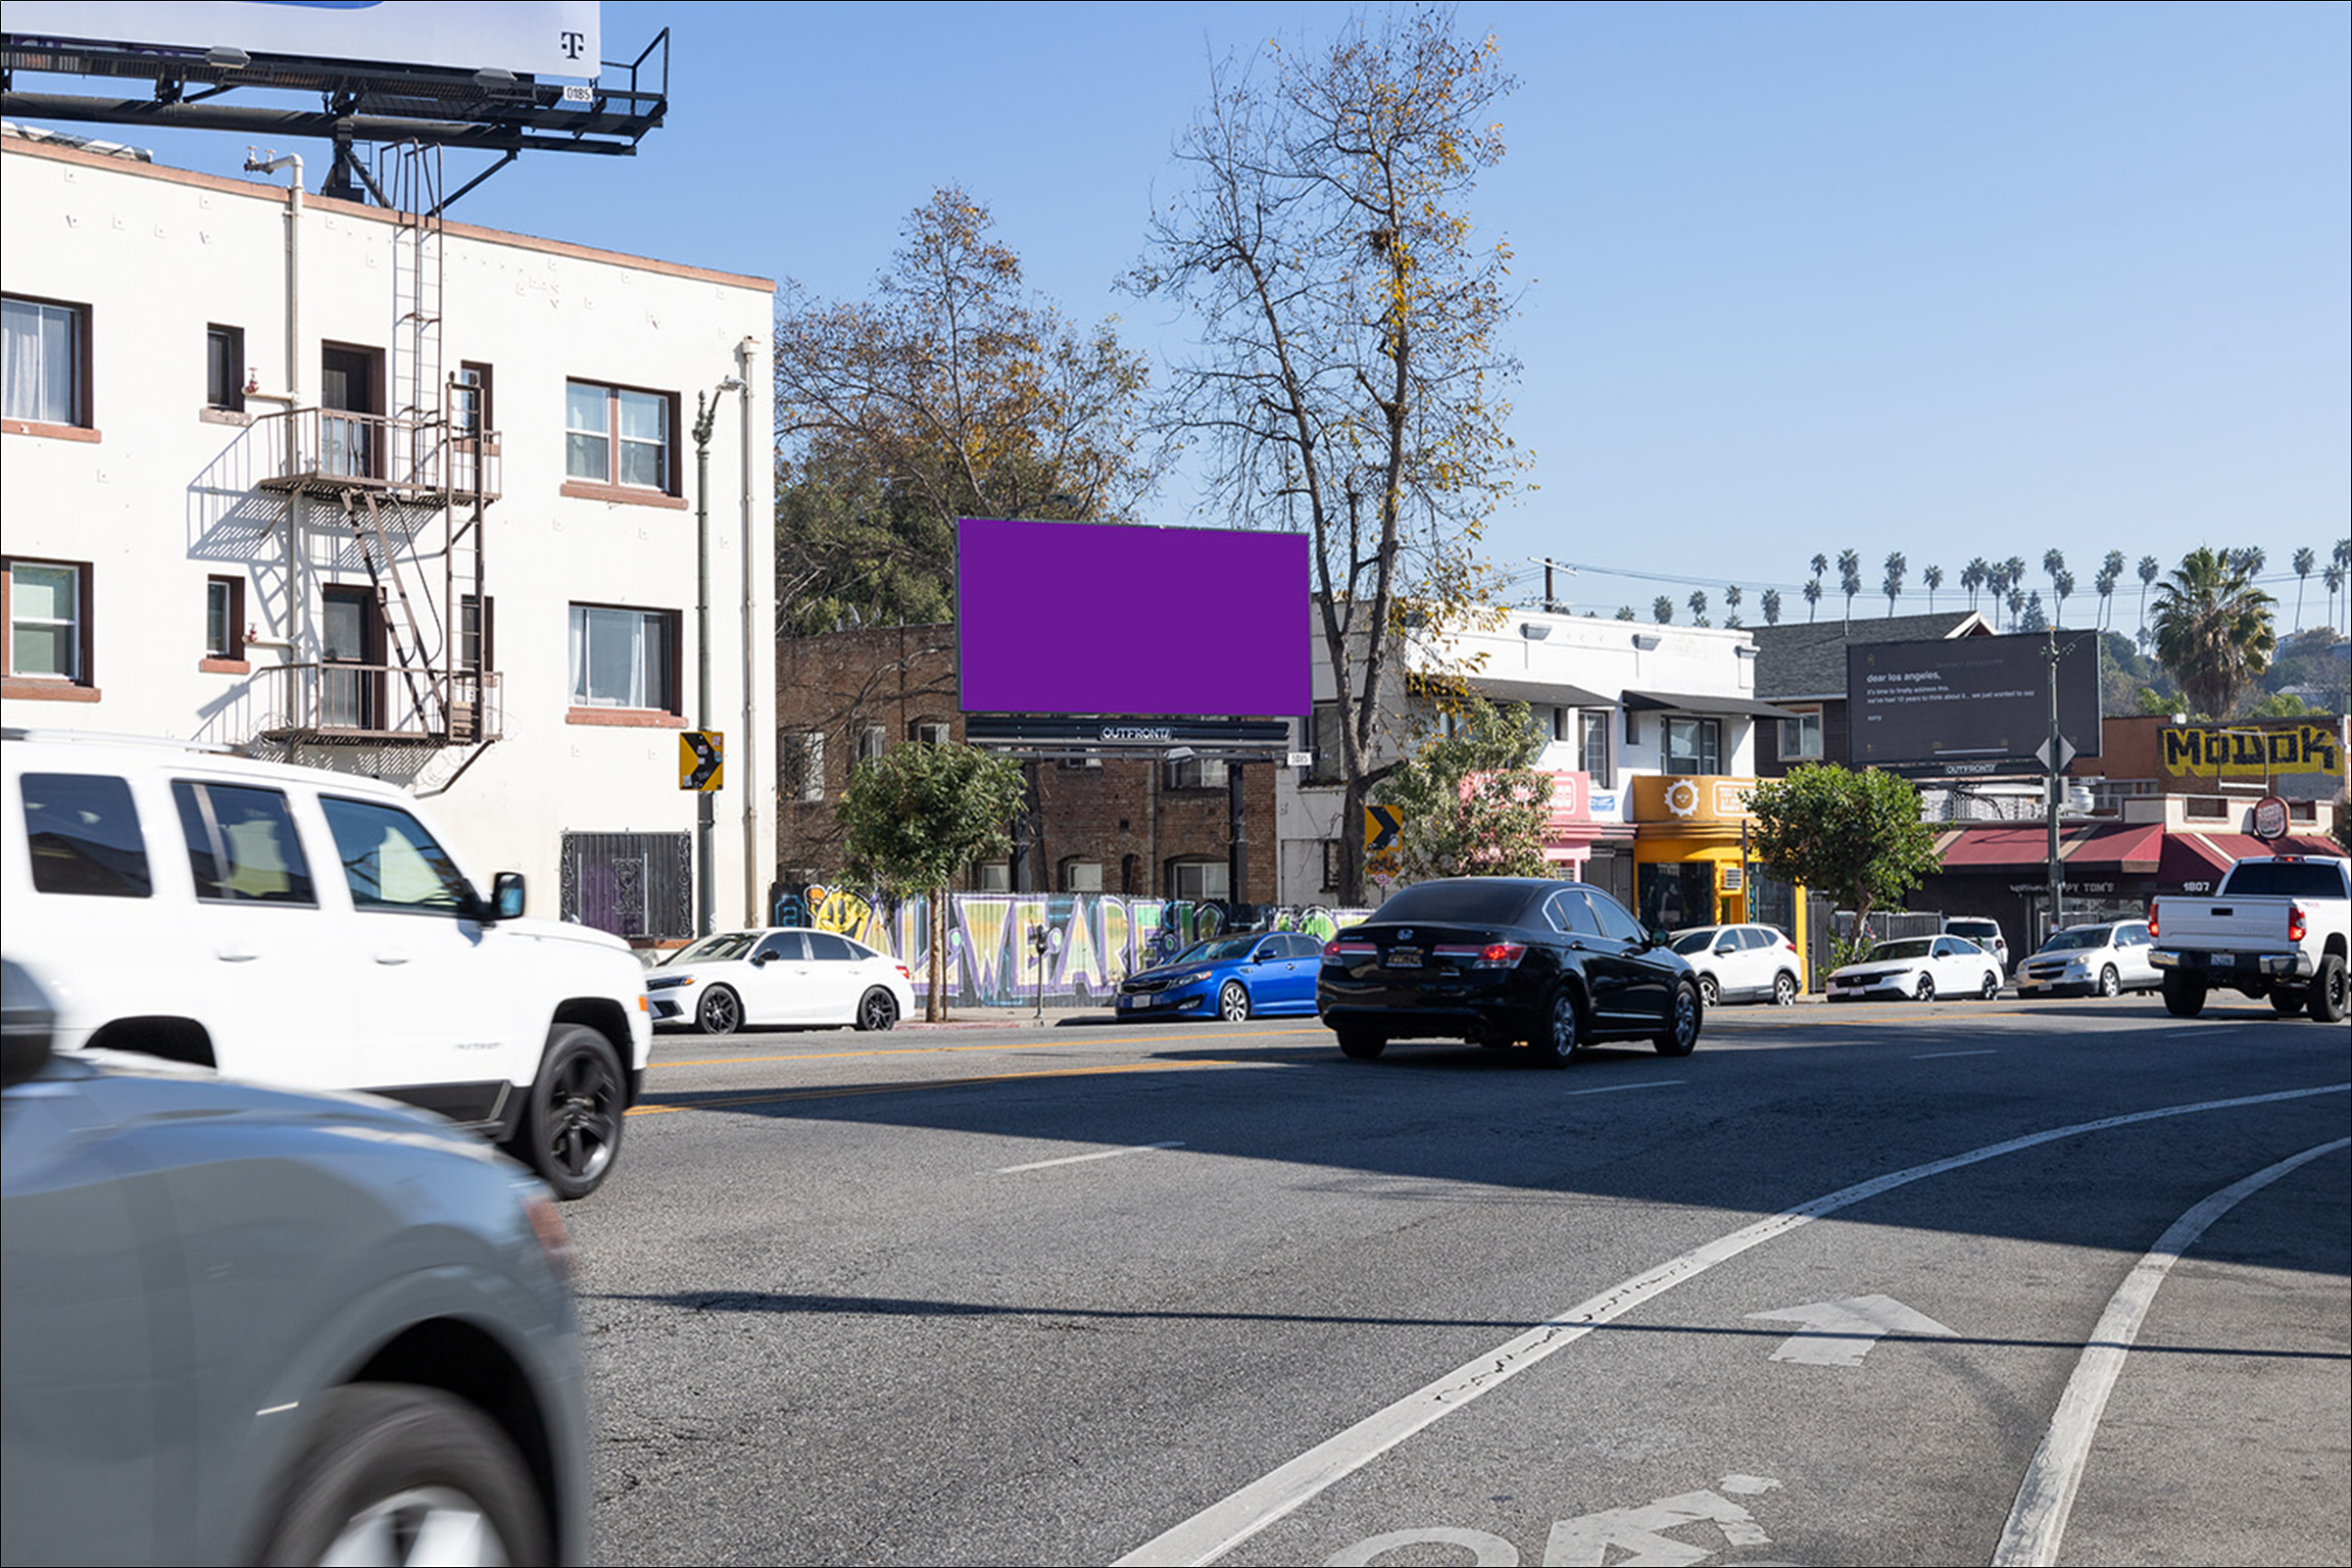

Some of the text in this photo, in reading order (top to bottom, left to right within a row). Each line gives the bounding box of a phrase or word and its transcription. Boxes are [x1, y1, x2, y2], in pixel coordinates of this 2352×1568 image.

[1866, 670, 1941, 683] dear los angeles,
[1982, 691, 1993, 700] just
[2083, 882, 2115, 893] TOM'S
[2182, 882, 2211, 892] 1807
